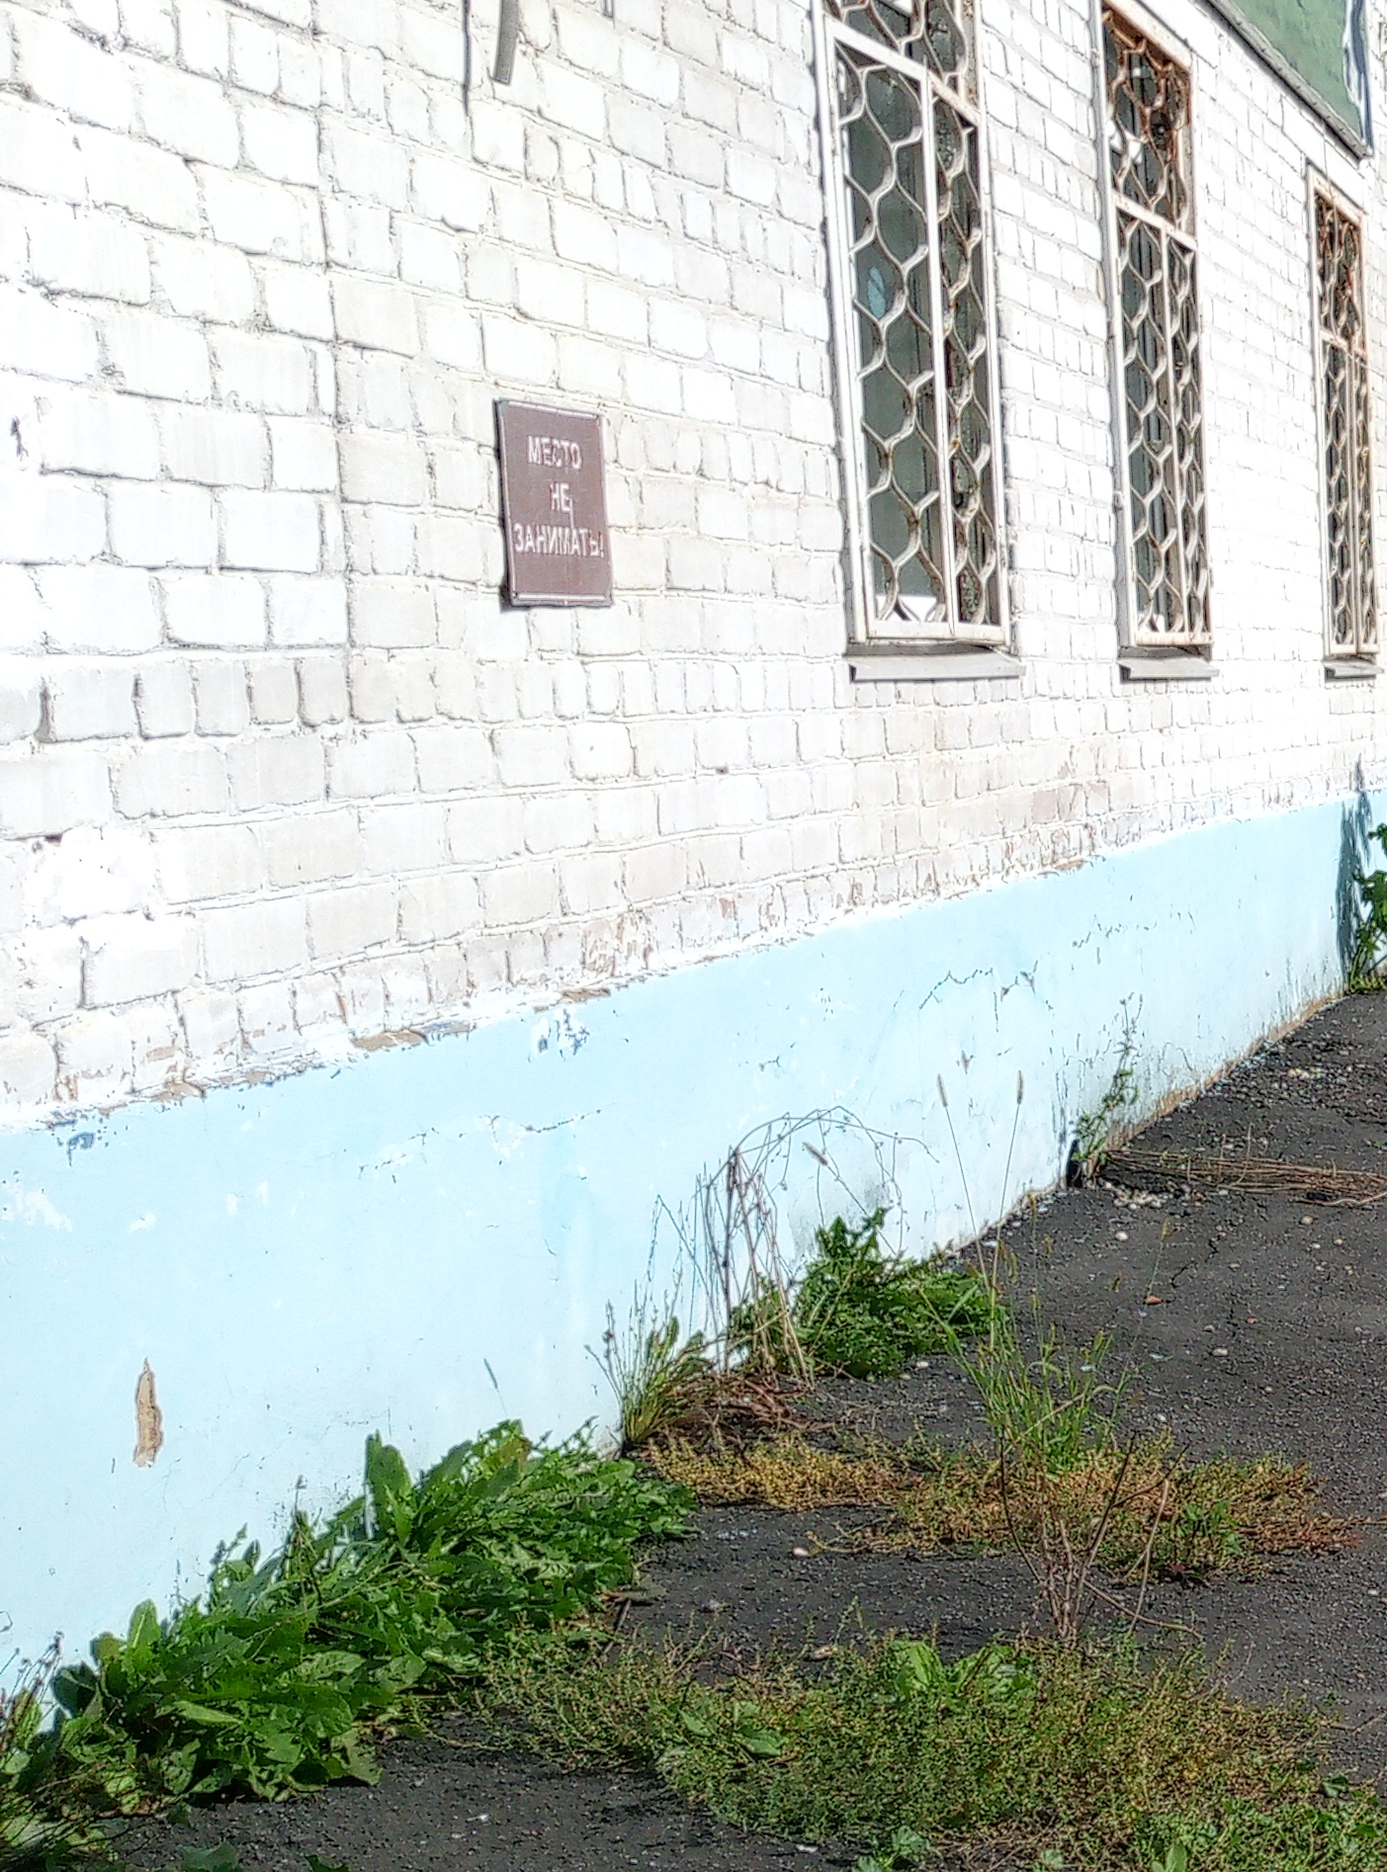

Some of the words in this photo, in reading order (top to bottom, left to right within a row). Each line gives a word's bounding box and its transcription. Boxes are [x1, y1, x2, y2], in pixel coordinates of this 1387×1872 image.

[527, 435, 582, 469] МЕСТО
[549, 482, 572, 512] НЕ
[513, 522, 604, 558] ЗАНИМАТЬ!
